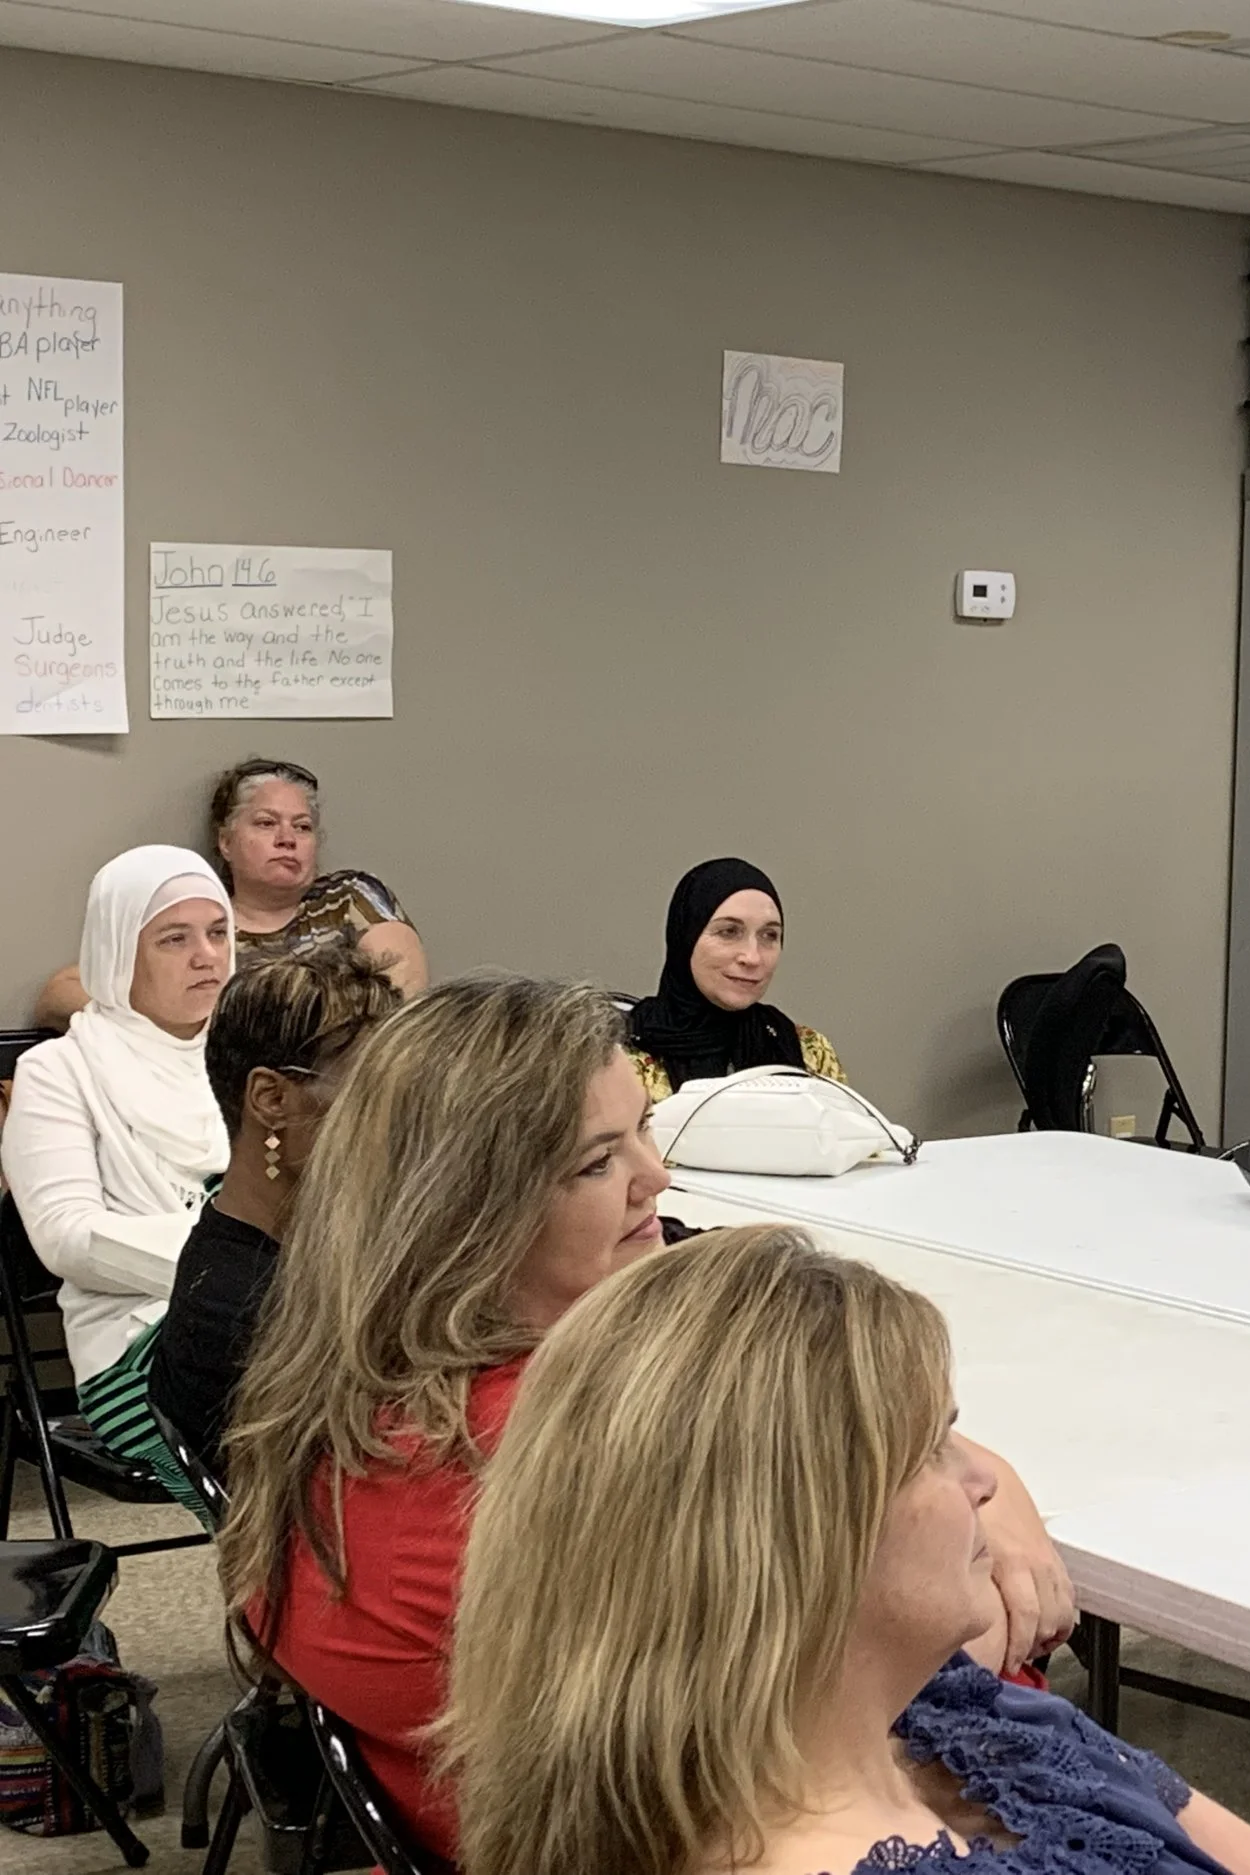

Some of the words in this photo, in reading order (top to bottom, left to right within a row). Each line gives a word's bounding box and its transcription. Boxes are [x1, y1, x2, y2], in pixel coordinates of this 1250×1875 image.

[36, 331, 100, 363] player
[27, 376, 64, 401] NFL
[64, 394, 118, 419] player
[3, 421, 89, 450] Zoologist
[0, 520, 91, 552] Engineer
[152, 550, 224, 586] John
[150, 595, 229, 625] Jesus
[13, 615, 93, 657] Judge
[150, 632, 181, 648] am
[188, 628, 217, 648] the
[223, 631, 255, 652] way
[262, 624, 300, 645] and
[310, 624, 350, 644] the
[14, 654, 118, 685] Surgeons
[153, 654, 207, 674] truth
[213, 652, 246, 669] and
[253, 650, 284, 667] the
[327, 650, 351, 667] No
[355, 653, 383, 666] one
[211, 673, 229, 690] to
[234, 672, 262, 690] the
[329, 678, 376, 690] except
[15, 687, 106, 714] dentists
[153, 693, 214, 714] through
